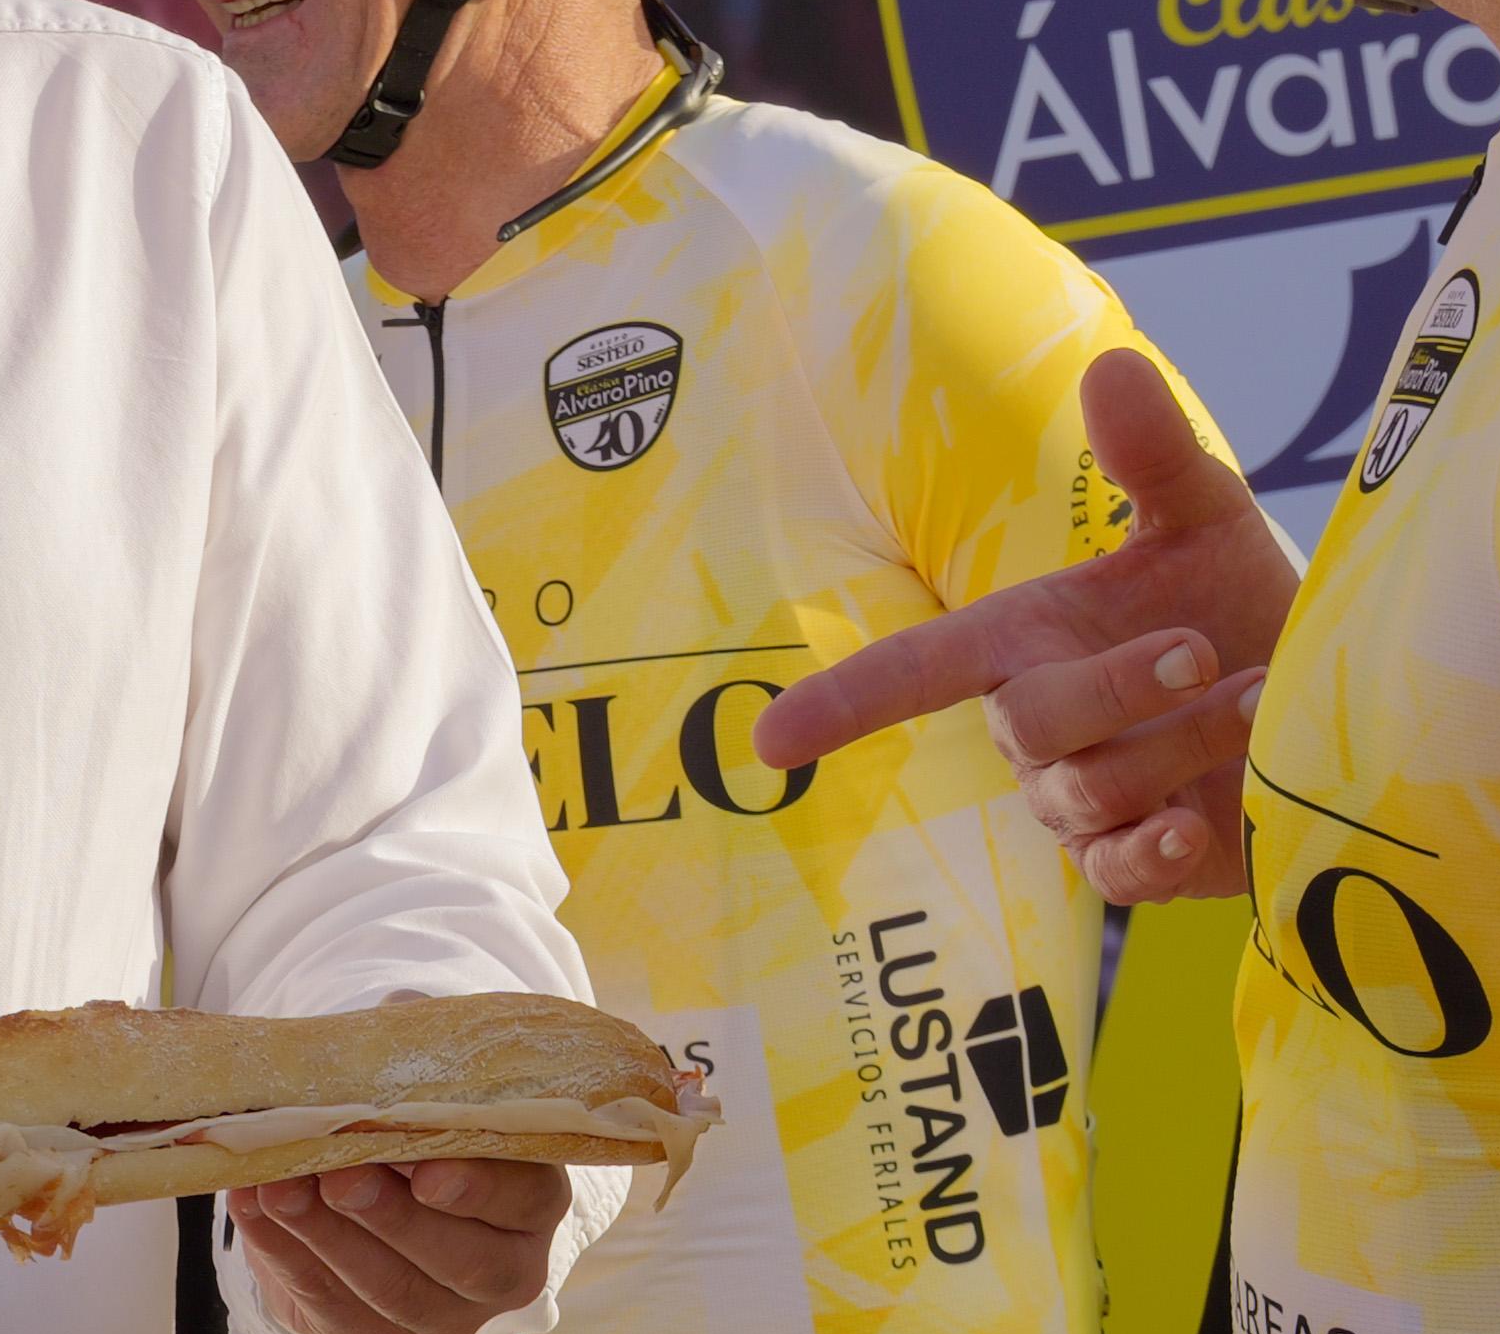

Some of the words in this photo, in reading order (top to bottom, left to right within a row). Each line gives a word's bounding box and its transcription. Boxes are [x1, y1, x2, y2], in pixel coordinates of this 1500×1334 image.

[831, 931, 887, 1104] SERVICIOS
[867, 1123, 917, 1271] FERIALES
[869, 910, 986, 1267] LUSTAND
